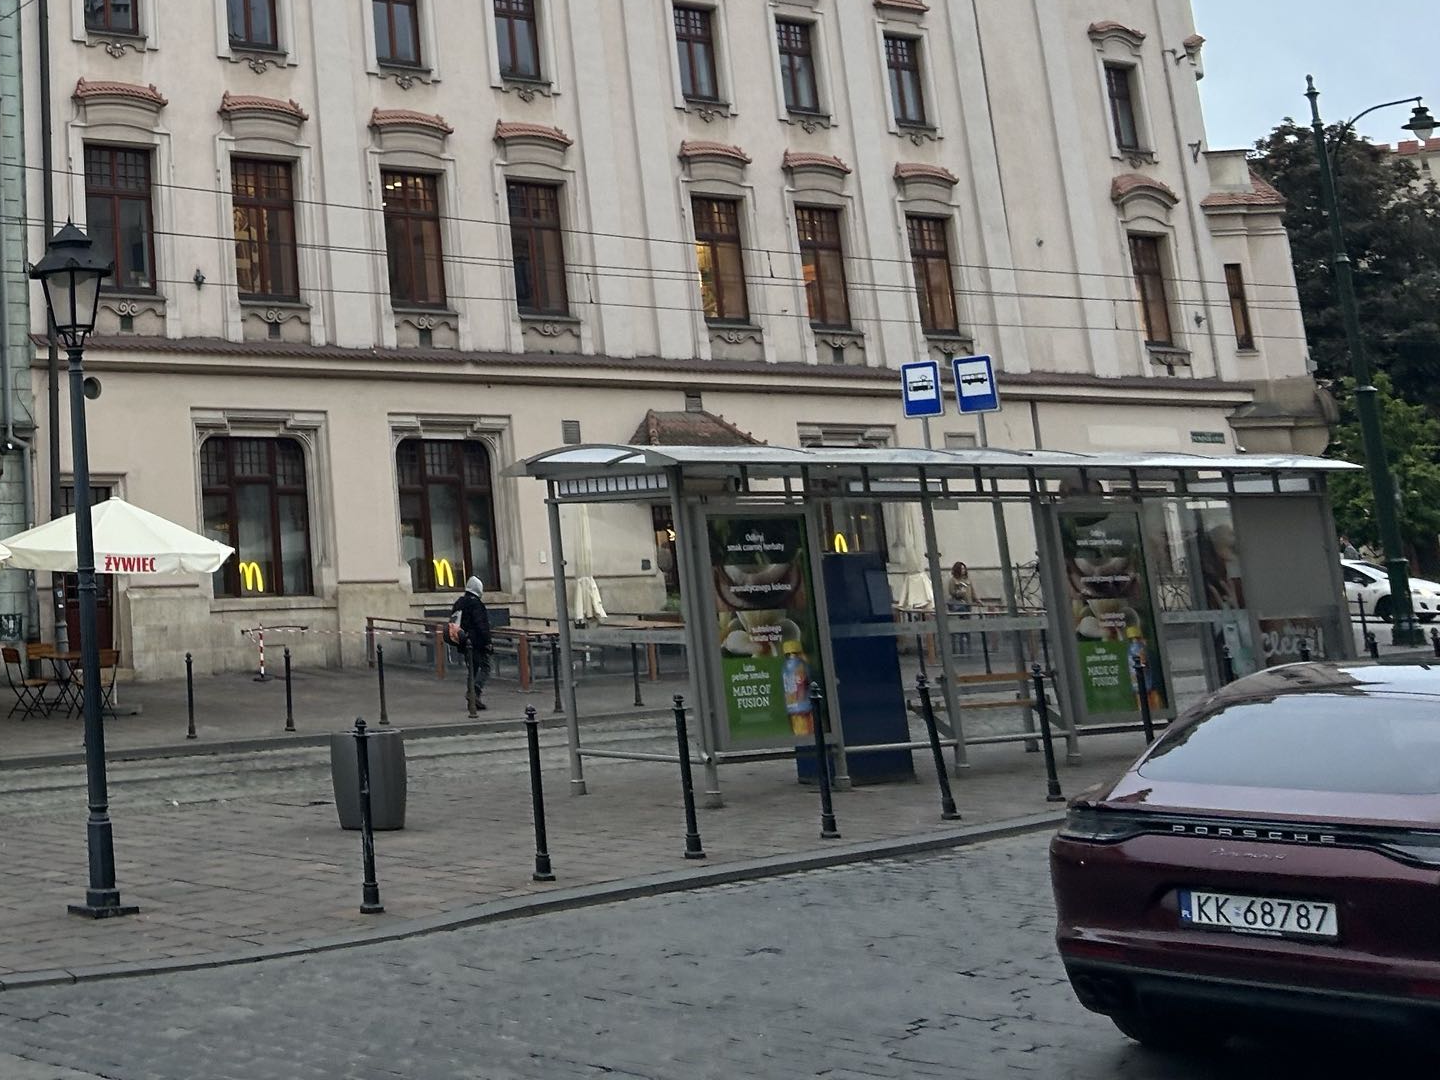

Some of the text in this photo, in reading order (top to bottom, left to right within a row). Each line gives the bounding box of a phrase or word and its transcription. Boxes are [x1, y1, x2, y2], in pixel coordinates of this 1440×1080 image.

[104, 554, 157, 573] ŻYWIEC
[732, 684, 771, 697] MADE OF
[737, 696, 770, 709] FUSION
[1172, 824, 1336, 844] PORSCHE
[1196, 895, 1329, 933] KK 68787
